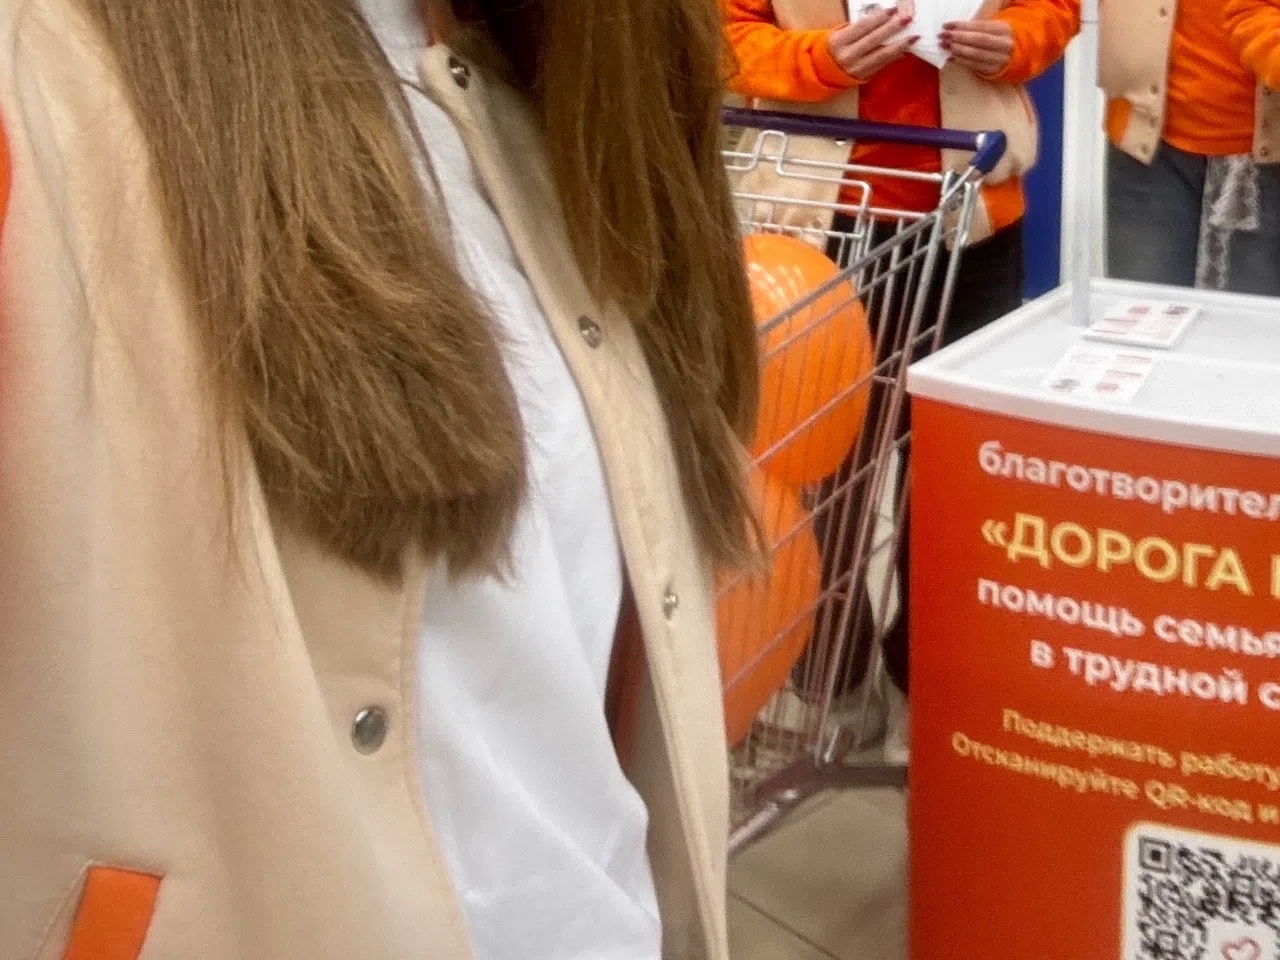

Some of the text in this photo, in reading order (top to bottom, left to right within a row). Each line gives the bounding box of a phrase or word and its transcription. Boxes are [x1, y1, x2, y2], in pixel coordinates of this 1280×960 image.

[981, 512, 1253, 596] «ДОРОГА
[977, 578, 1146, 637] помощь
[1030, 639, 1055, 670] в
[1062, 646, 1249, 706] трудной
[1002, 708, 1177, 769] Поддержать
[951, 731, 1141, 800] Отсканируйте
[1143, 779, 1254, 823] QR-код
[1257, 803, 1280, 825] и
